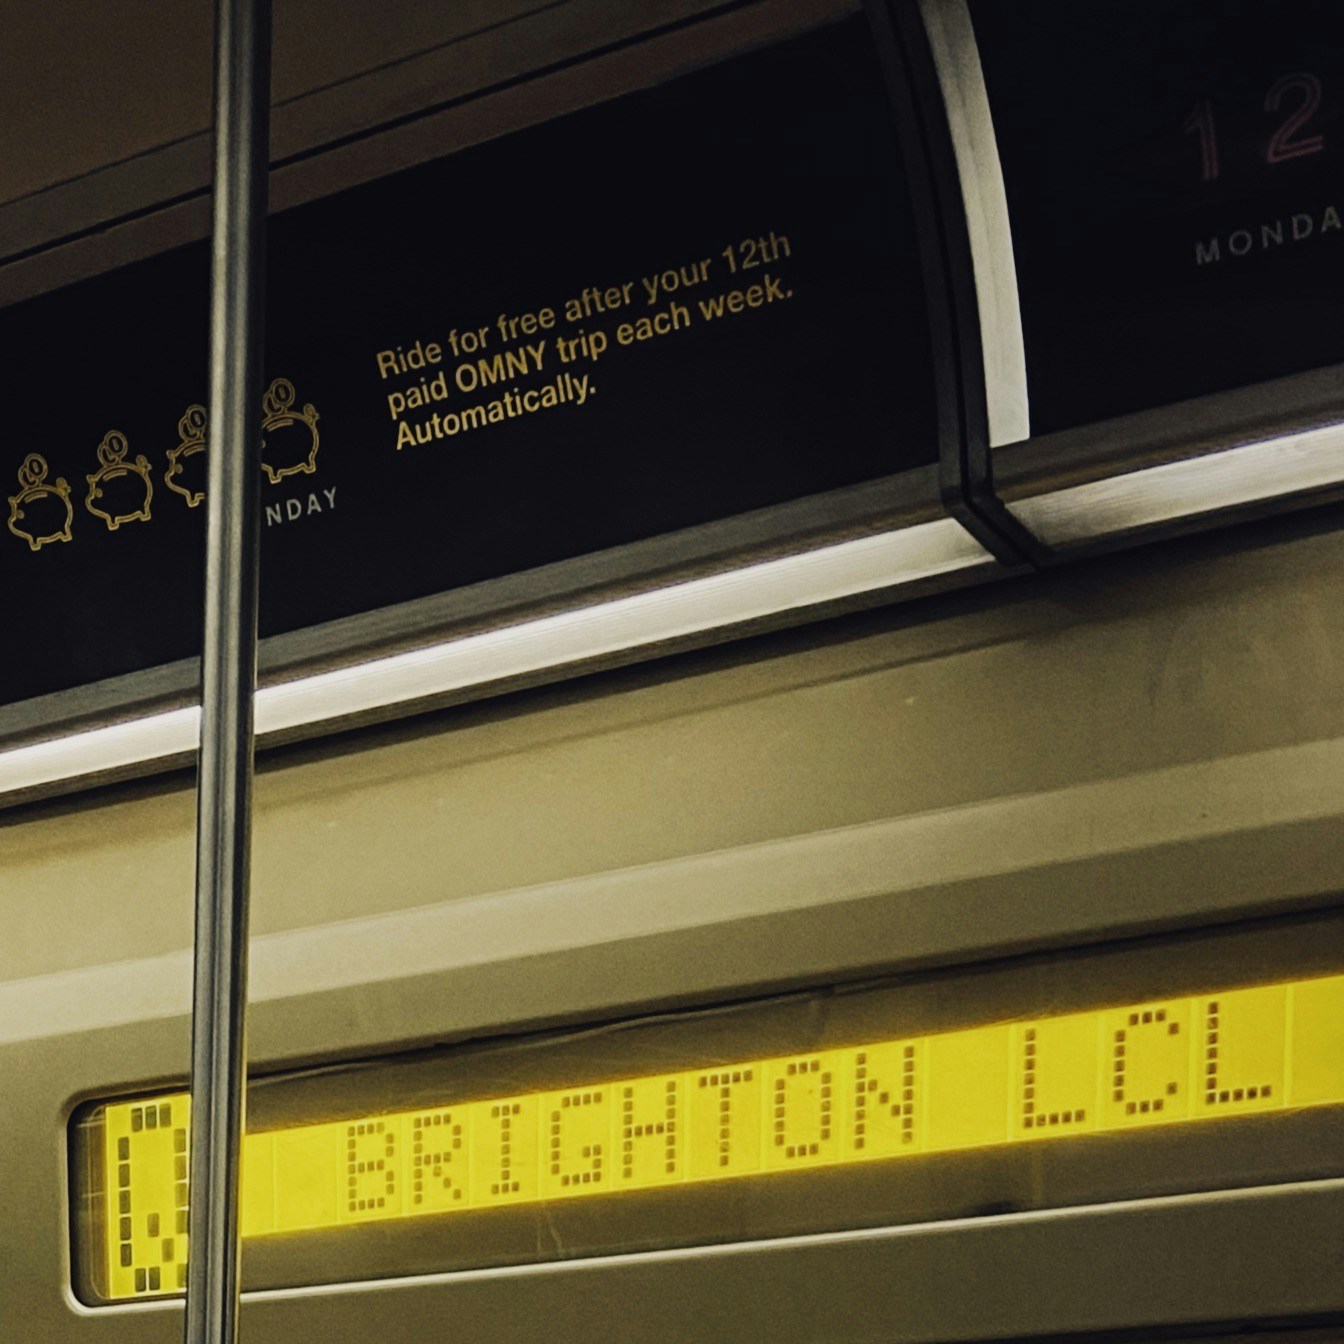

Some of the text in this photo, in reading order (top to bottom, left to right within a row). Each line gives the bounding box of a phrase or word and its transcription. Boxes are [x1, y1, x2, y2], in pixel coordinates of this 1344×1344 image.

[1195, 205, 1343, 265] MONDA
[376, 232, 792, 379] Ride for free after your 12th
[388, 274, 794, 420] paid OMNY trip each week.
[396, 373, 596, 450] Automatically.
[265, 486, 337, 527] NDAY
[346, 1046, 914, 1212] BRIGHTON
[1022, 1002, 1272, 1131] LCL
